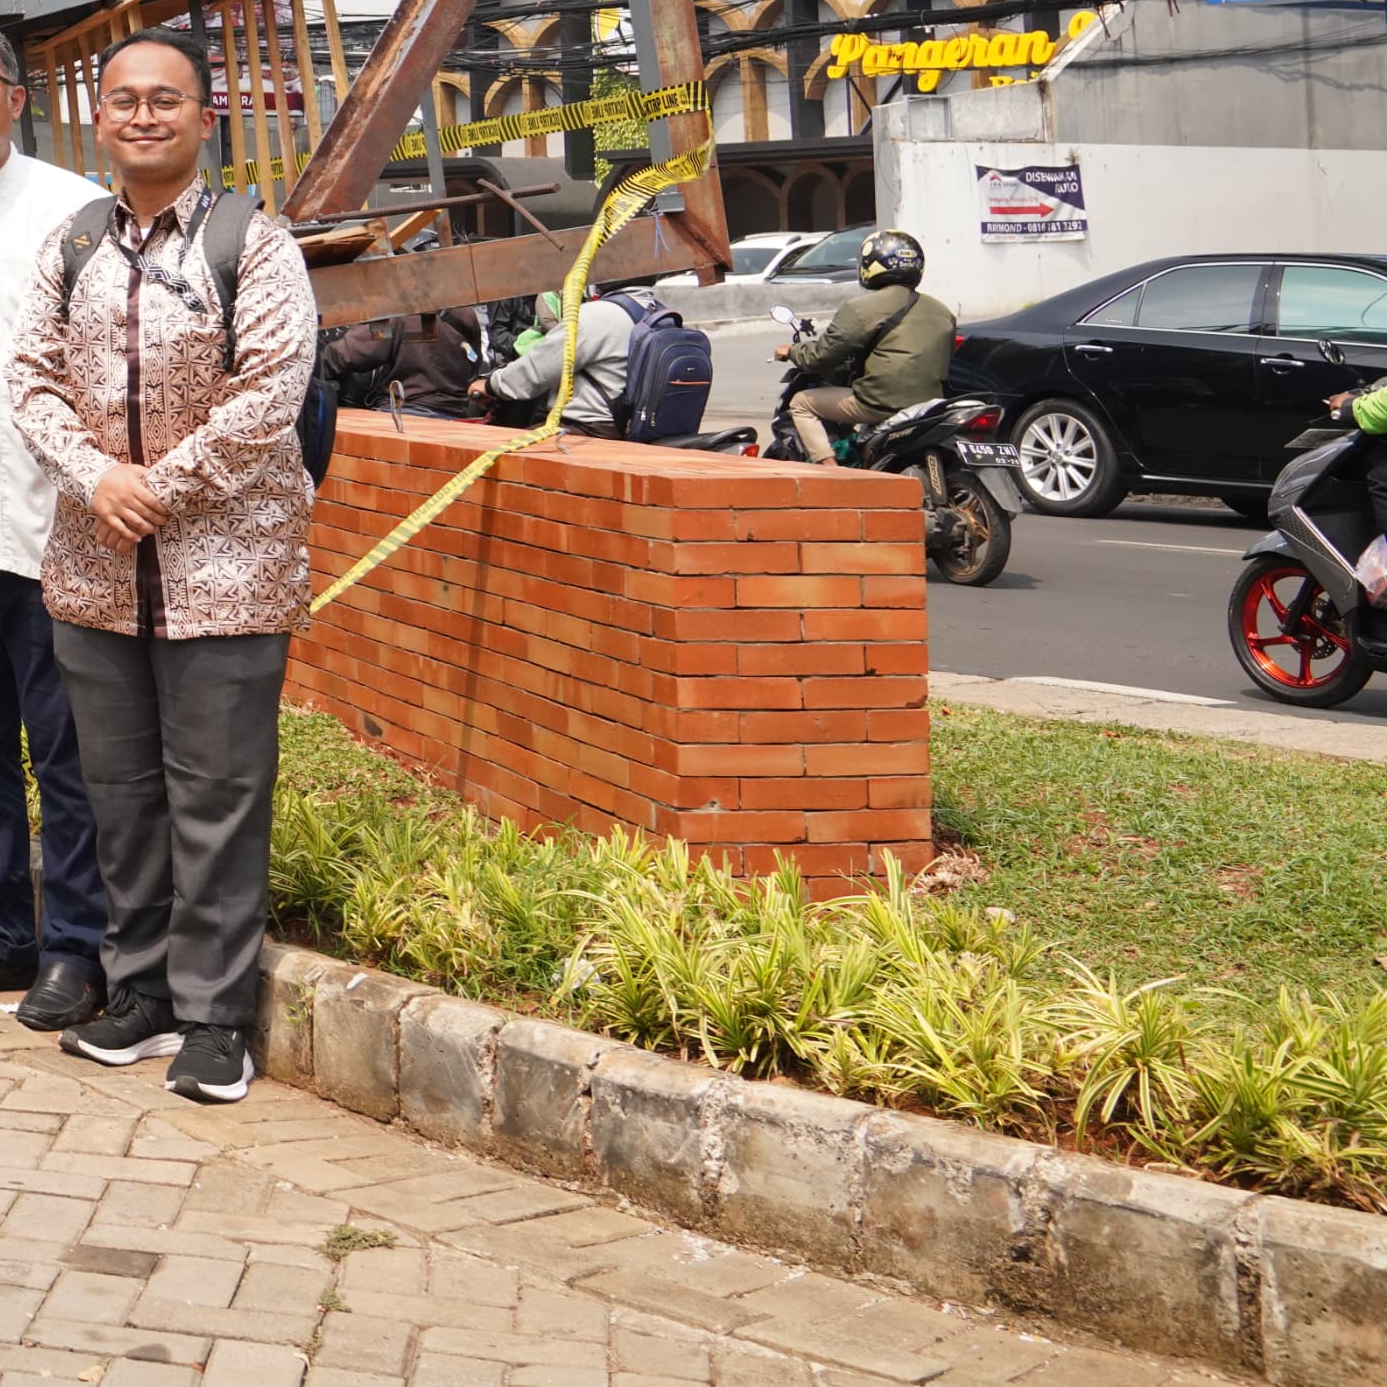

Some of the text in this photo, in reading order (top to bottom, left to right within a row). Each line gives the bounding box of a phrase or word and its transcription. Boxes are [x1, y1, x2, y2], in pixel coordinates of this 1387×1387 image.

[827, 31, 1056, 92] Pangeran
[662, 93, 679, 108] LINE
[1025, 172, 1077, 183] DISEWAKAN
